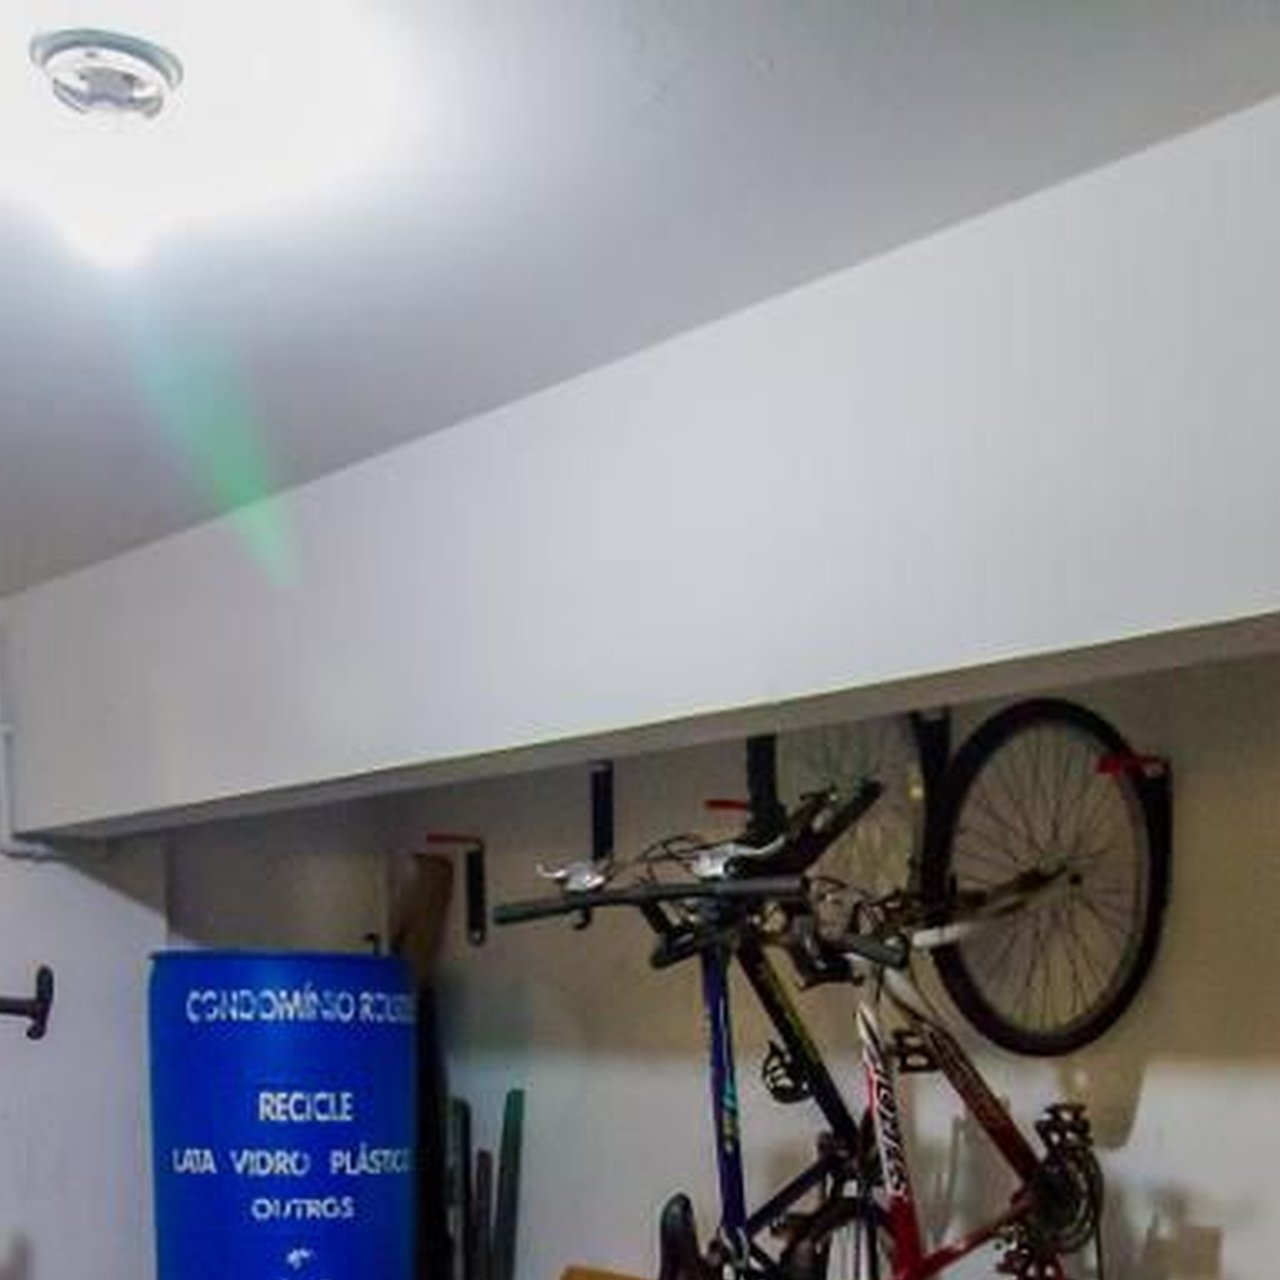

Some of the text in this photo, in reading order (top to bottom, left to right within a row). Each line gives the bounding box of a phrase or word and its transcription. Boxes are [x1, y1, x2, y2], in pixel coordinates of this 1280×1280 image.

[258, 1091, 354, 1122] RECICLE
[172, 1147, 218, 1175] LATA
[229, 1148, 311, 1177] VIDRO
[250, 1196, 355, 1221] OUTROS
